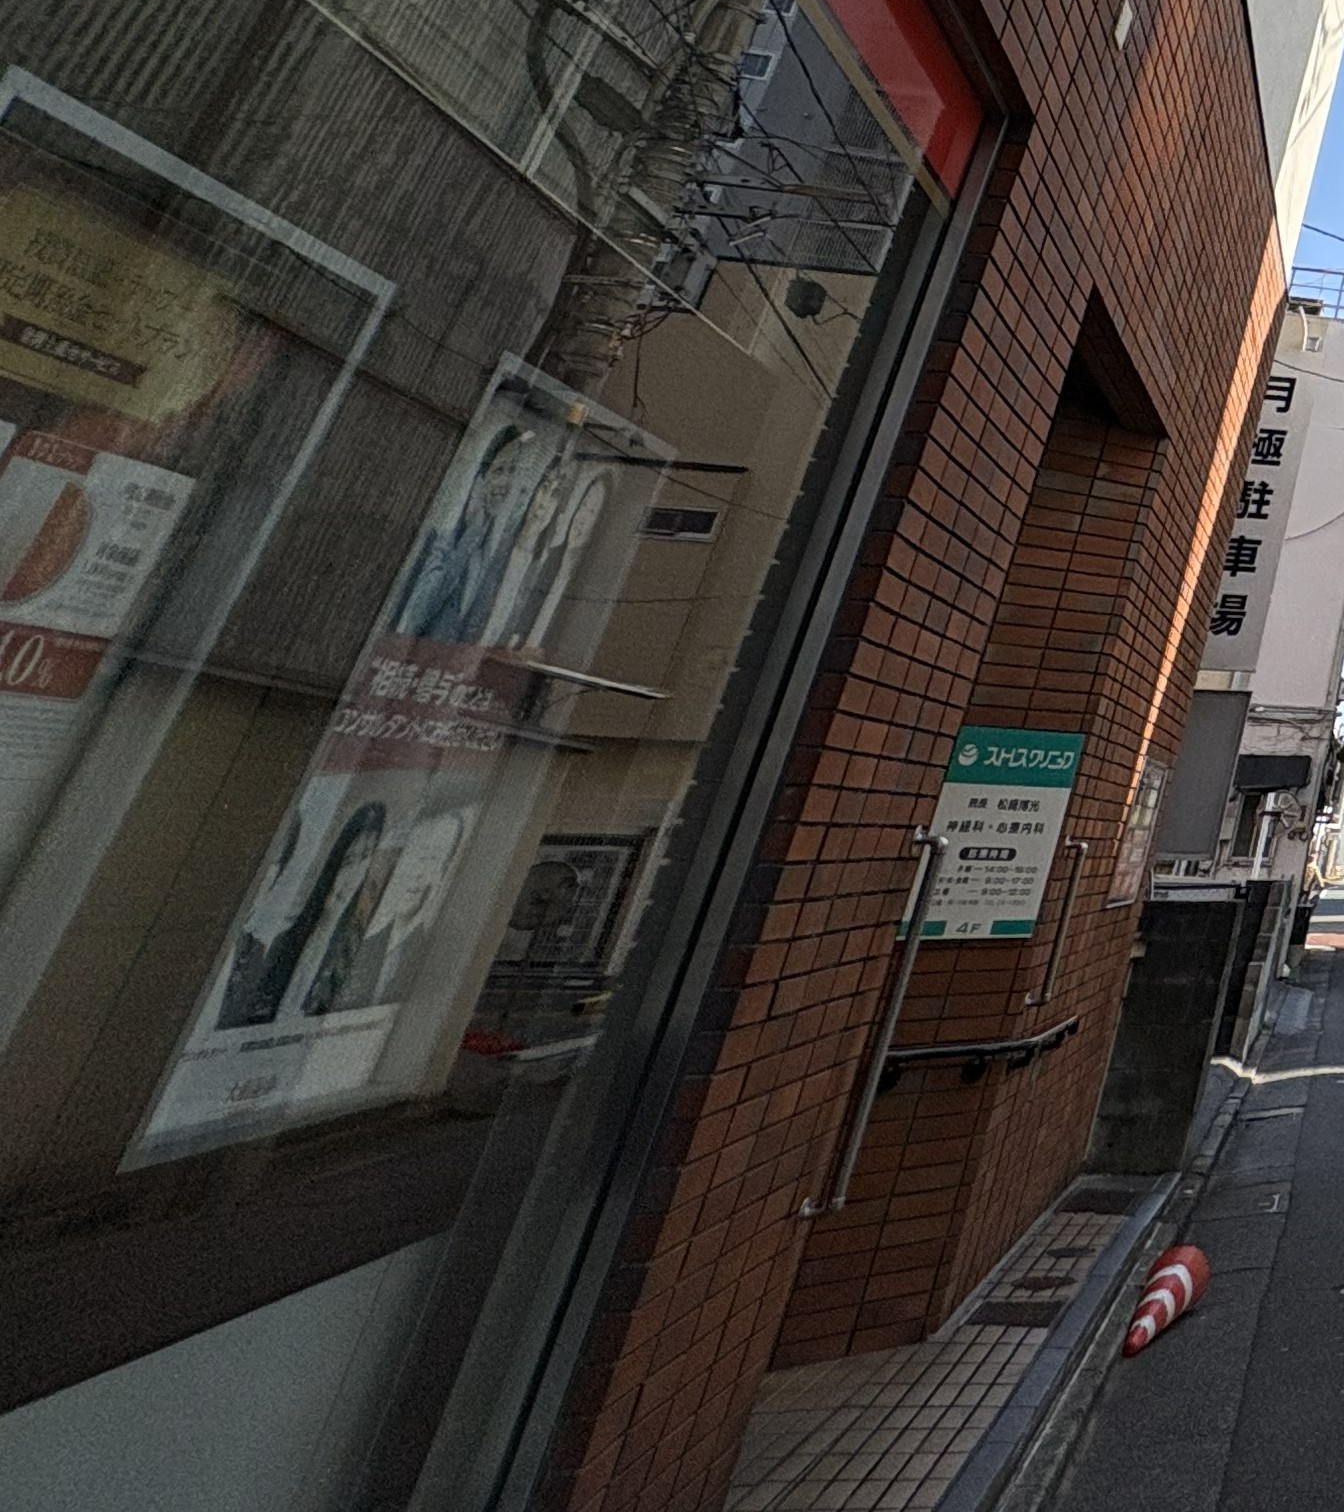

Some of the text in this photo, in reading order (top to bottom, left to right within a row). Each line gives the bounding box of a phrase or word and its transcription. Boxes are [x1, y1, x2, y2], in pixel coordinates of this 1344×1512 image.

[983, 745, 1075, 770] ストレスクリニック
[954, 922, 982, 935] 4F
